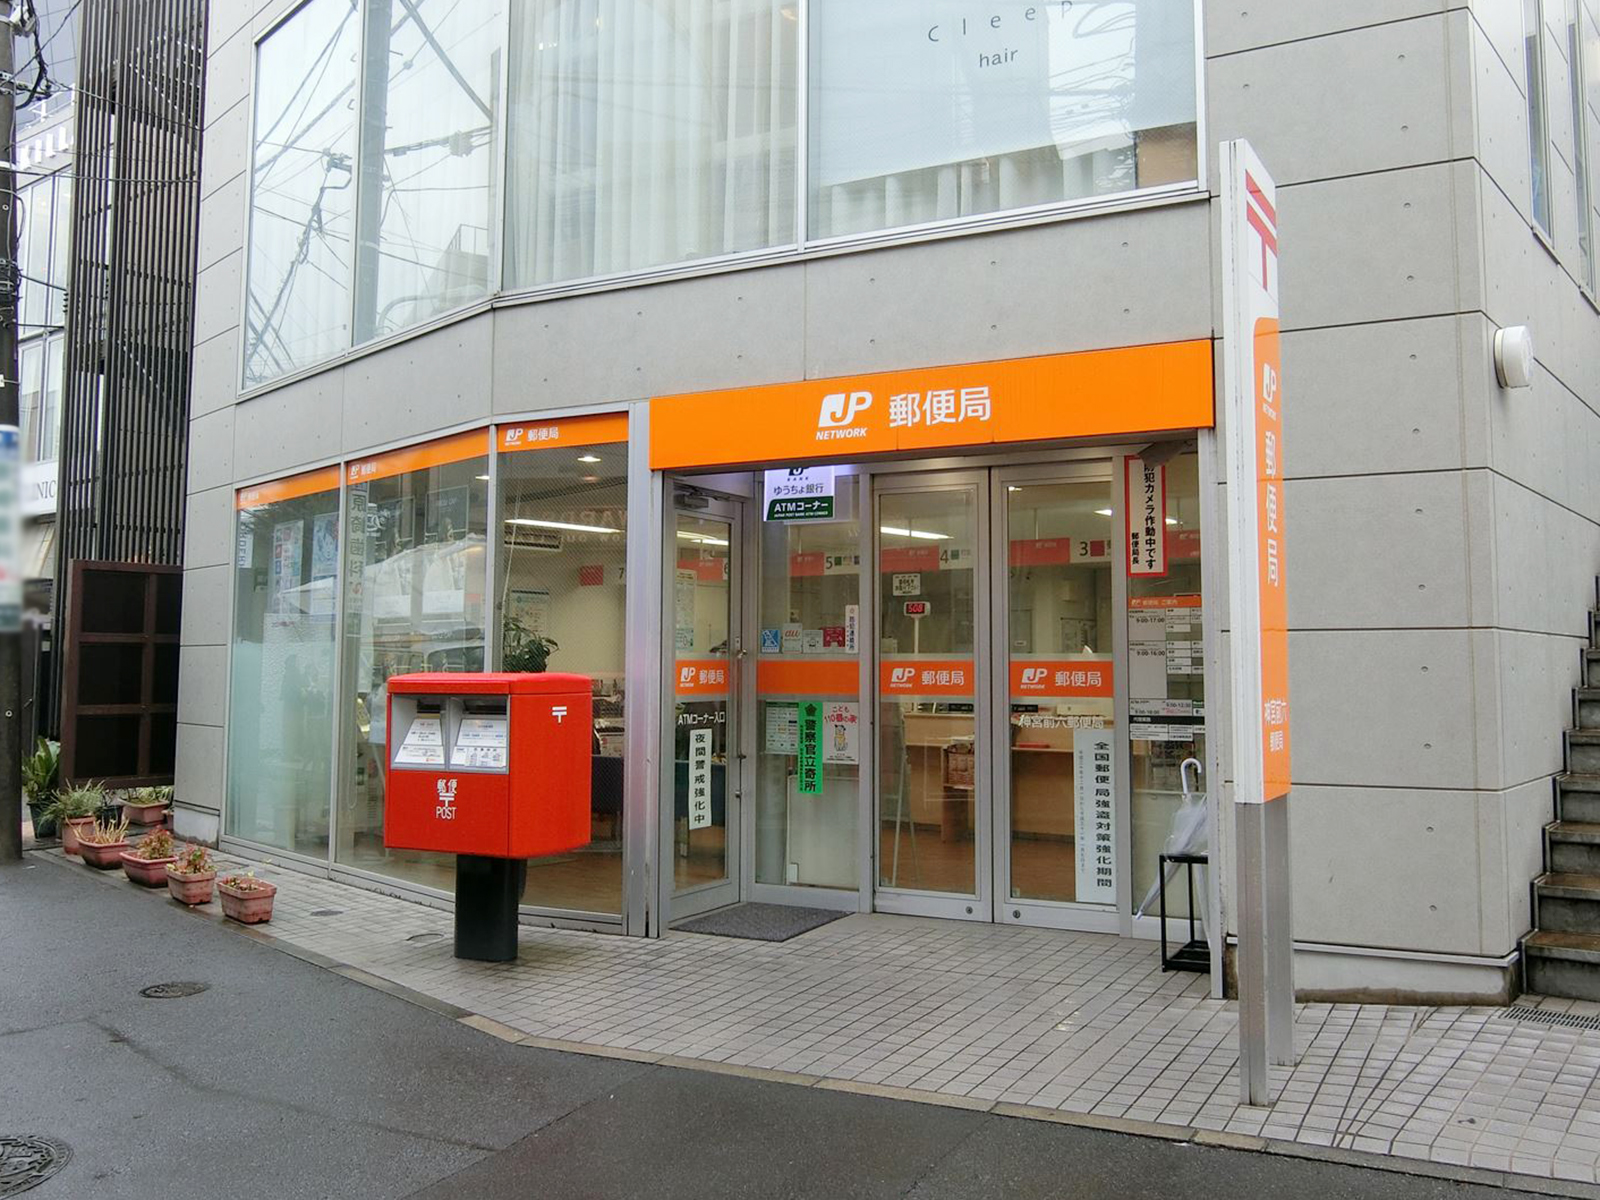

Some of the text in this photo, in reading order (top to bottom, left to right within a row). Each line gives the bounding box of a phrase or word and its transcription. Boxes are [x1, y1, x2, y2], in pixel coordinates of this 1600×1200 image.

[979, 48, 1018, 67] hair
[20, 126, 74, 171] KILL
[818, 391, 873, 428] JP
[888, 386, 991, 428] 郵便局
[815, 427, 867, 441] NETWORK
[773, 482, 825, 496] ゆうちょ銀行
[773, 501, 829, 513] ATMコーナー
[1079, 541, 1088, 556] 3
[825, 556, 833, 570] 5
[940, 549, 949, 564] 4
[699, 669, 724, 684] 郵便局
[891, 668, 915, 682] JP
[921, 670, 965, 686] 郵便局
[1022, 668, 1047, 683] JP
[1055, 671, 1102, 687] 郵便局
[832, 705, 850, 714] こども
[677, 711, 726, 726] ATMコーナー入口
[1019, 714, 1104, 730] 神宮前六郵便局
[804, 719, 817, 792] 警察官立寄所
[437, 778, 458, 794] 郵便
[694, 733, 706, 824] 夜間警戒強化中
[435, 806, 457, 820] POST
[1094, 741, 1112, 887] 全国郵便局強盗対策強化期間
